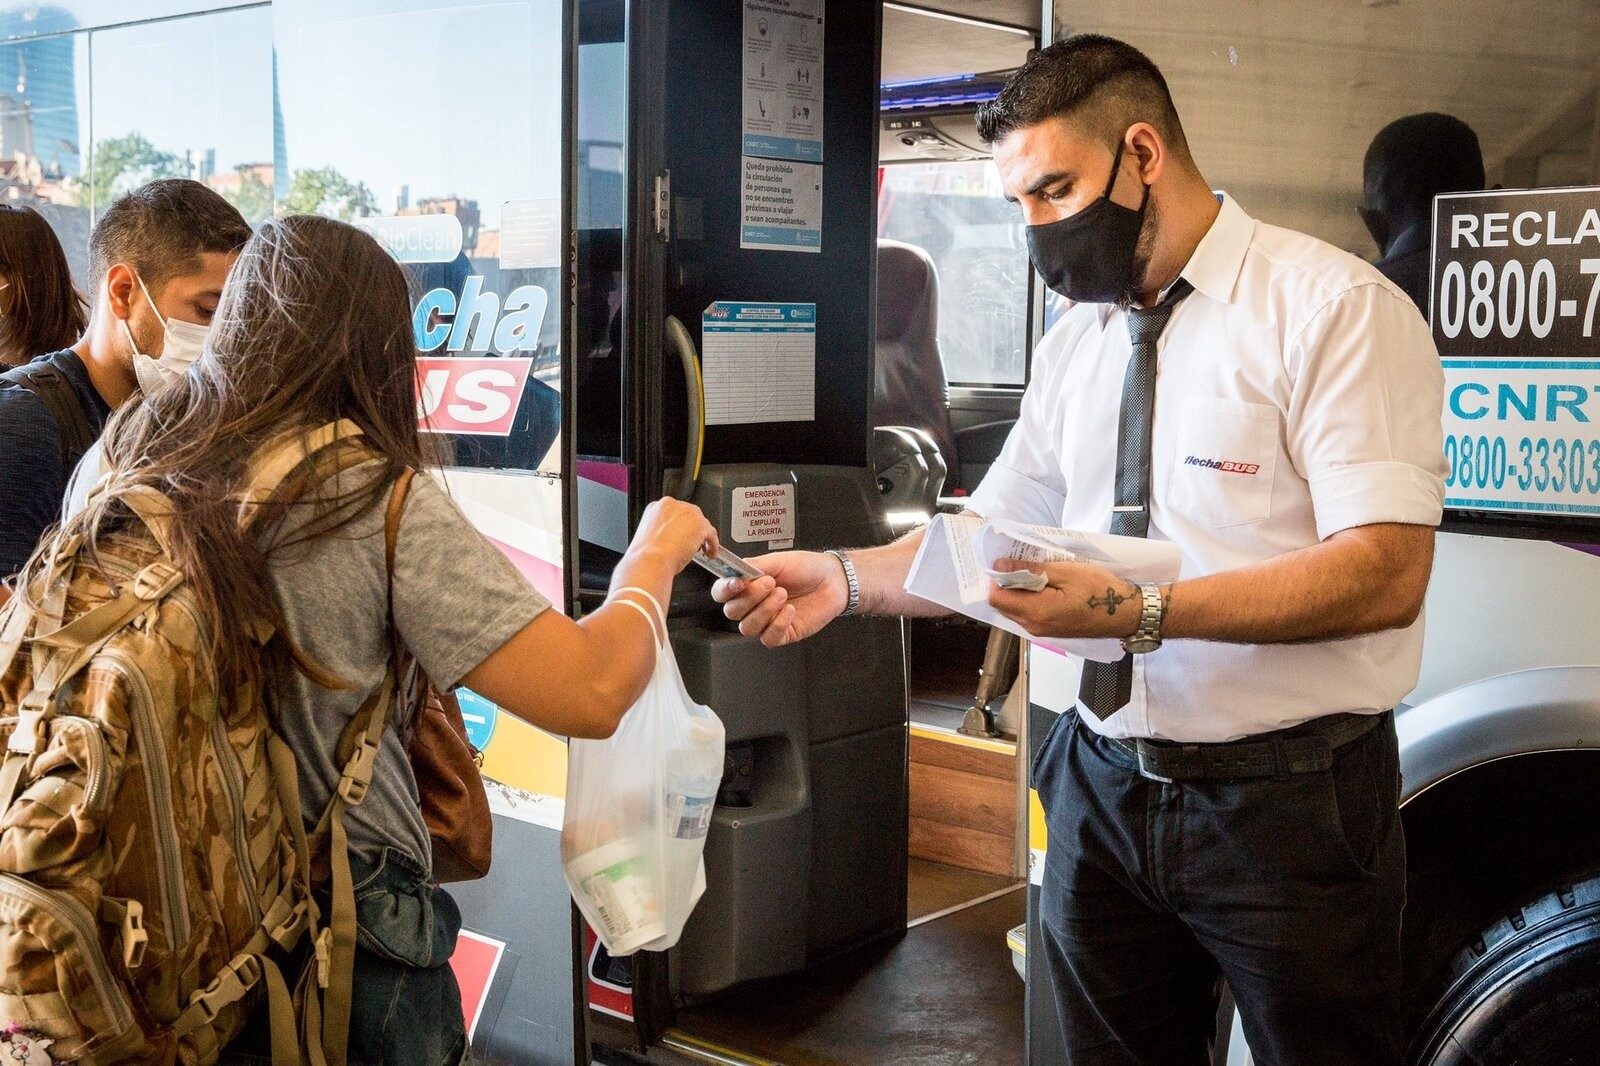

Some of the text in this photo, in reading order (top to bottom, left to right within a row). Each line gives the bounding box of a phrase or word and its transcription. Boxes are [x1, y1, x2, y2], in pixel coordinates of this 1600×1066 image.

[746, 162, 793, 174] Queda prohibida
[745, 172, 783, 182] la circulación
[745, 182, 753, 190] de
[754, 185, 780, 194] personas
[745, 204, 772, 213] próximas
[778, 206, 794, 215] viajar
[765, 217, 807, 226] acompañantes.
[1450, 208, 1600, 248] RECLA
[1440, 258, 1600, 338] 0800-7
[1444, 434, 1600, 495] 0800-33303
[745, 490, 785, 498] EMERGENCIA
[743, 508, 786, 517] INTERRUPTOR
[750, 518, 780, 526] EMPUJAR
[758, 527, 782, 535] PUERTA
